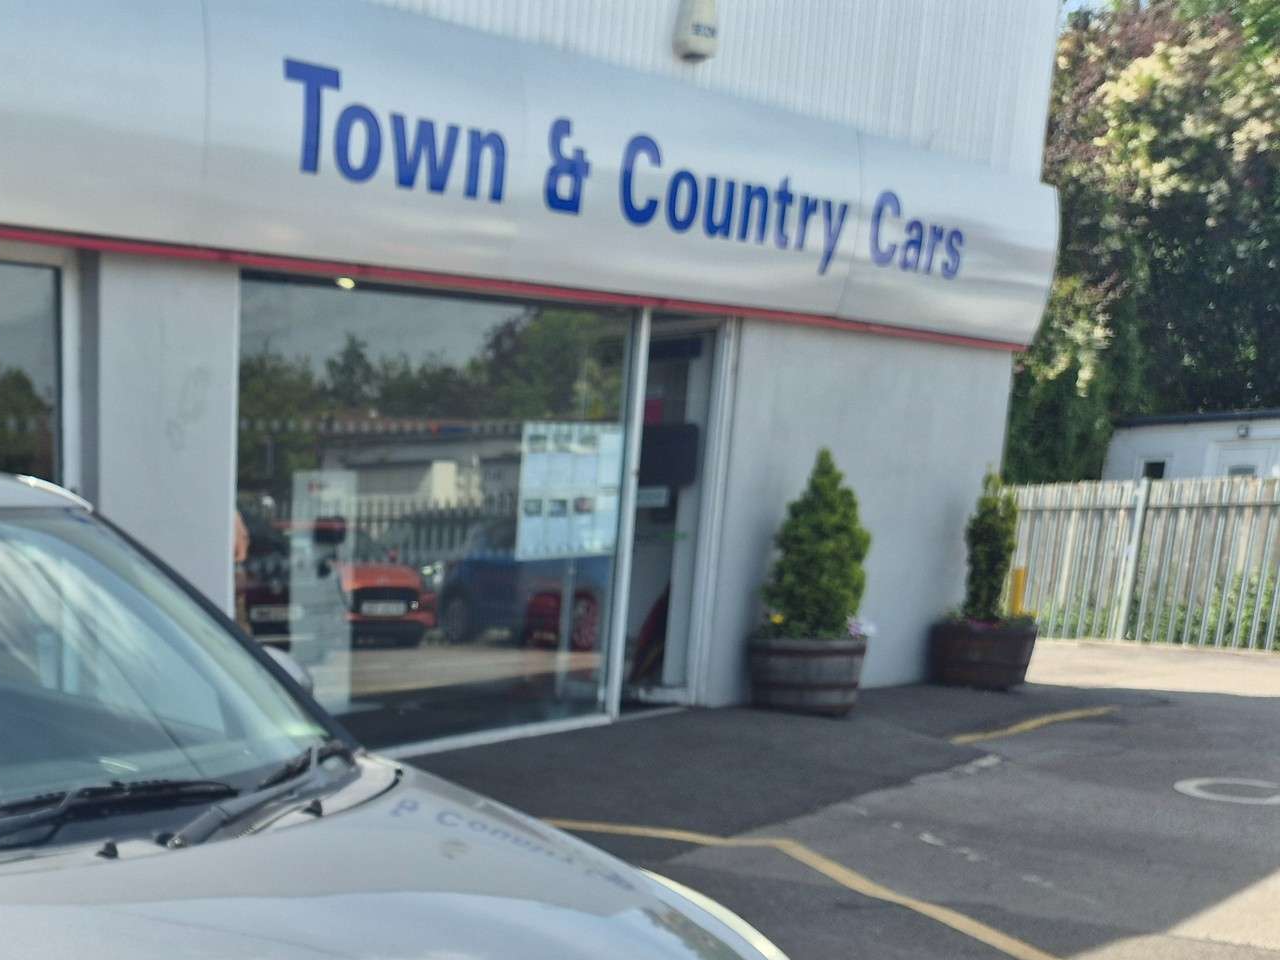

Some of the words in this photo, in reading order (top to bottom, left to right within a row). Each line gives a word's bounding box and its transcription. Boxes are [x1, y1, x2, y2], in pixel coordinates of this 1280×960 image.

[283, 56, 508, 204] Town
[543, 116, 591, 216] &
[619, 132, 850, 277] Country
[870, 189, 966, 280] Cars
